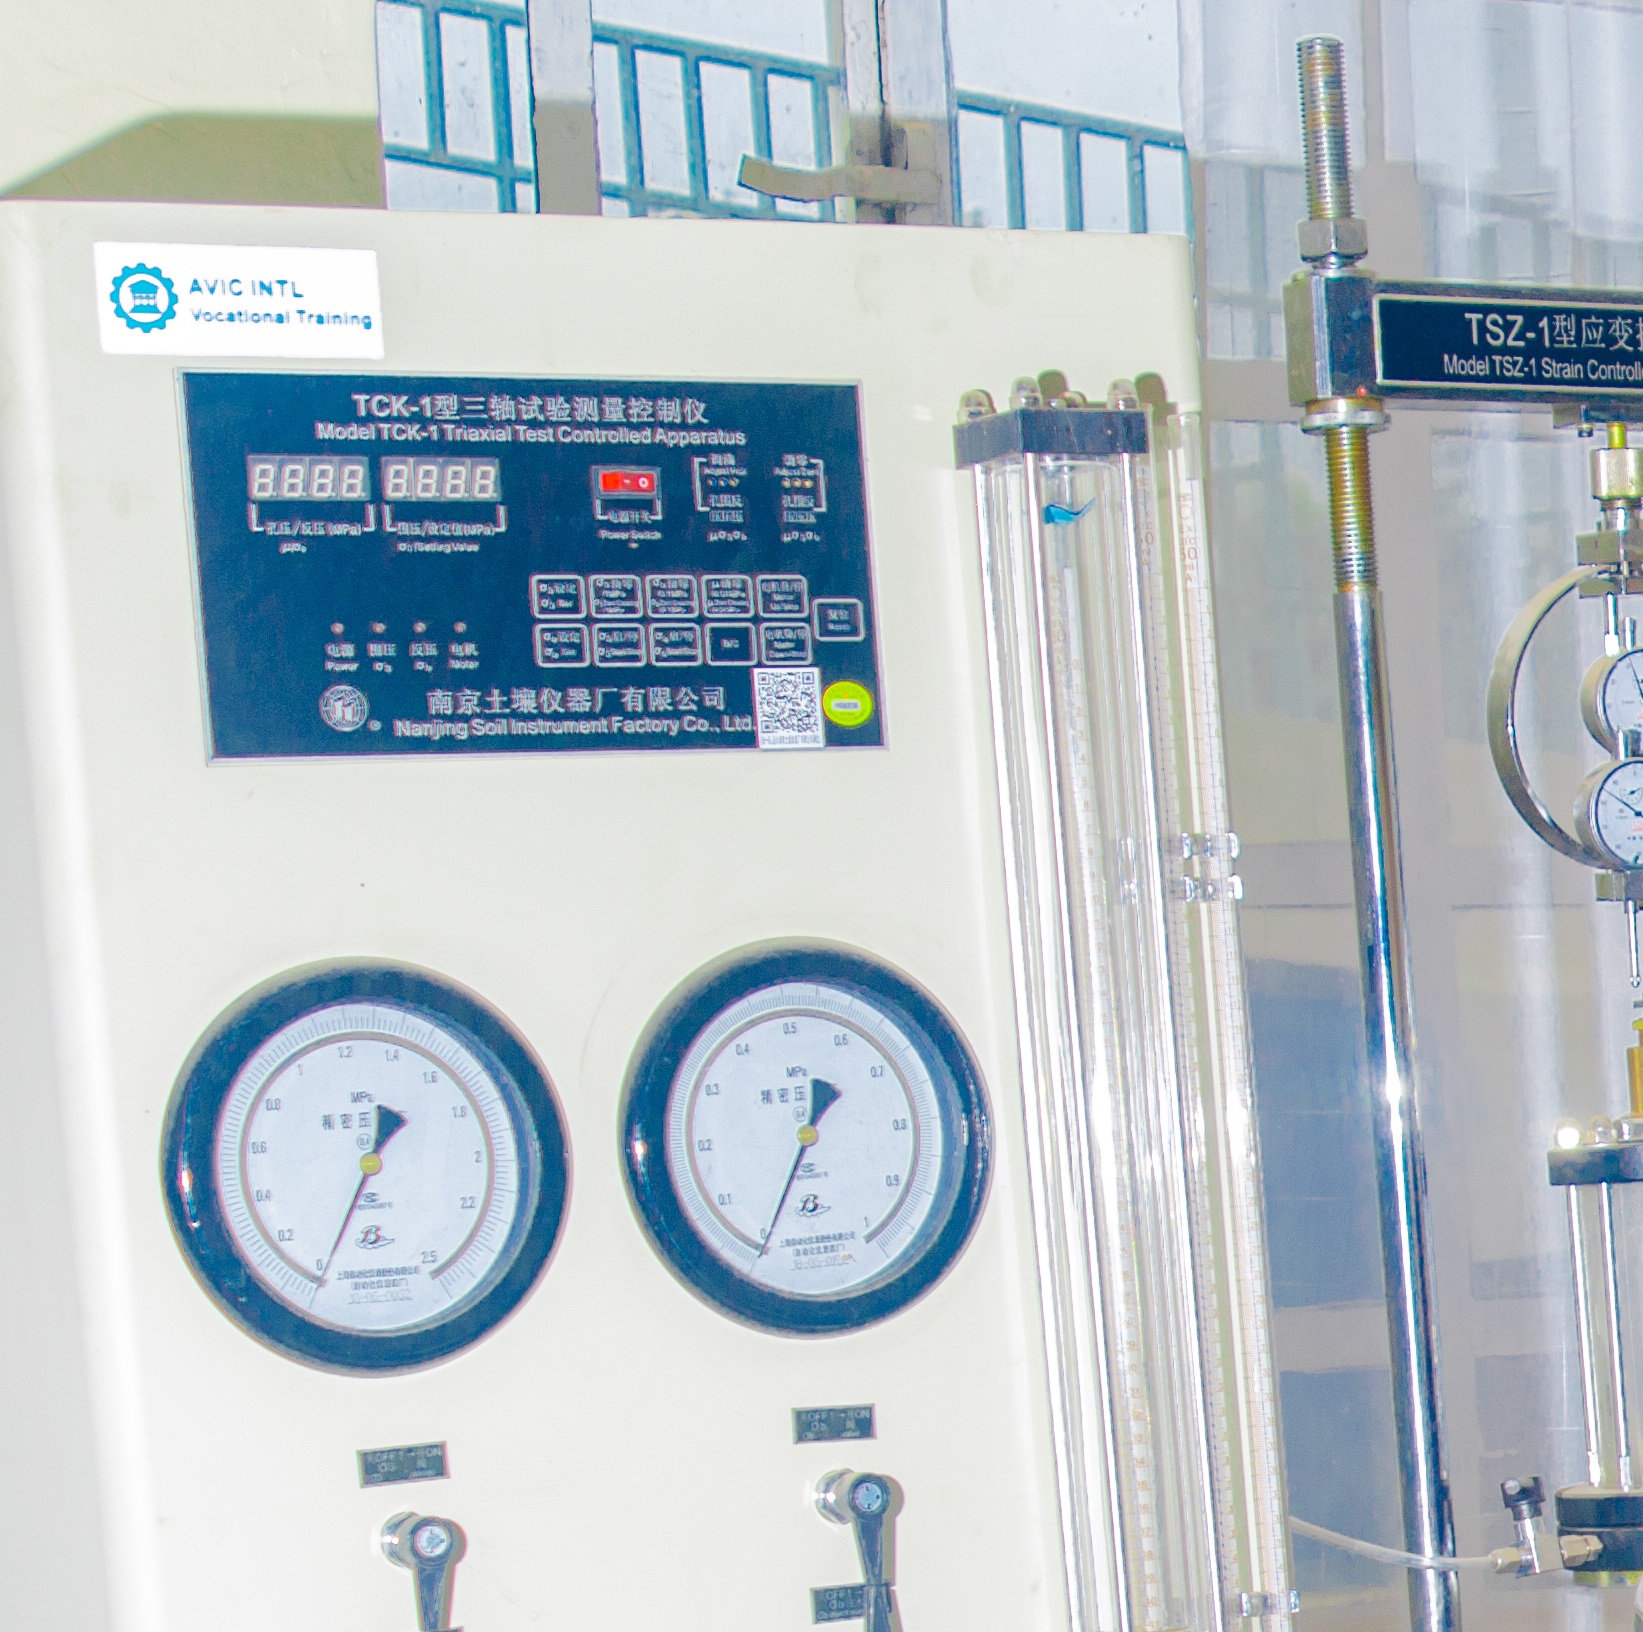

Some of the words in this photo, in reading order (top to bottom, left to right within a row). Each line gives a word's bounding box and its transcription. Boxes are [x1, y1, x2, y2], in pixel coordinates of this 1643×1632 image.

[189, 278, 244, 297] AVIC
[251, 279, 304, 298] INTL
[190, 308, 290, 324] Vocational
[296, 309, 372, 330] Training
[1443, 353, 1490, 377] Model
[1492, 355, 1537, 378] TSZ-1
[1541, 357, 1584, 380] Strain
[351, 393, 709, 424] TCK-1型三轴试验测量控制仪
[315, 422, 375, 442] Model
[379, 422, 438, 442] TCK-1
[443, 422, 512, 443] Triaxial
[515, 424, 554, 444] Test
[557, 425, 651, 446] Controlled
[655, 426, 746, 448] Apparatus
[426, 685, 726, 714] 南京土壤仪器厂有限公司
[394, 718, 468, 740] Nanjing
[470, 718, 507, 736] Soil
[509, 716, 608, 736] Instrument
[613, 715, 679, 736] Factory
[782, 1022, 797, 1035] 0.5
[834, 1034, 849, 1046] 0.6
[338, 1045, 353, 1058] 1.2
[735, 1043, 749, 1056] 0.4
[786, 1066, 807, 1078] MPa
[871, 1066, 884, 1078] 0.7
[705, 1083, 720, 1096] 0.3
[893, 1119, 907, 1131] 0.8
[698, 1138, 712, 1152] 0.2
[885, 1174, 899, 1187] 0.9
[718, 1193, 731, 1206] 0.1
[278, 1228, 294, 1241] 0.2
[760, 1228, 767, 1240] 0
[420, 1250, 437, 1264] 2.5
[316, 1258, 323, 1271] 0
